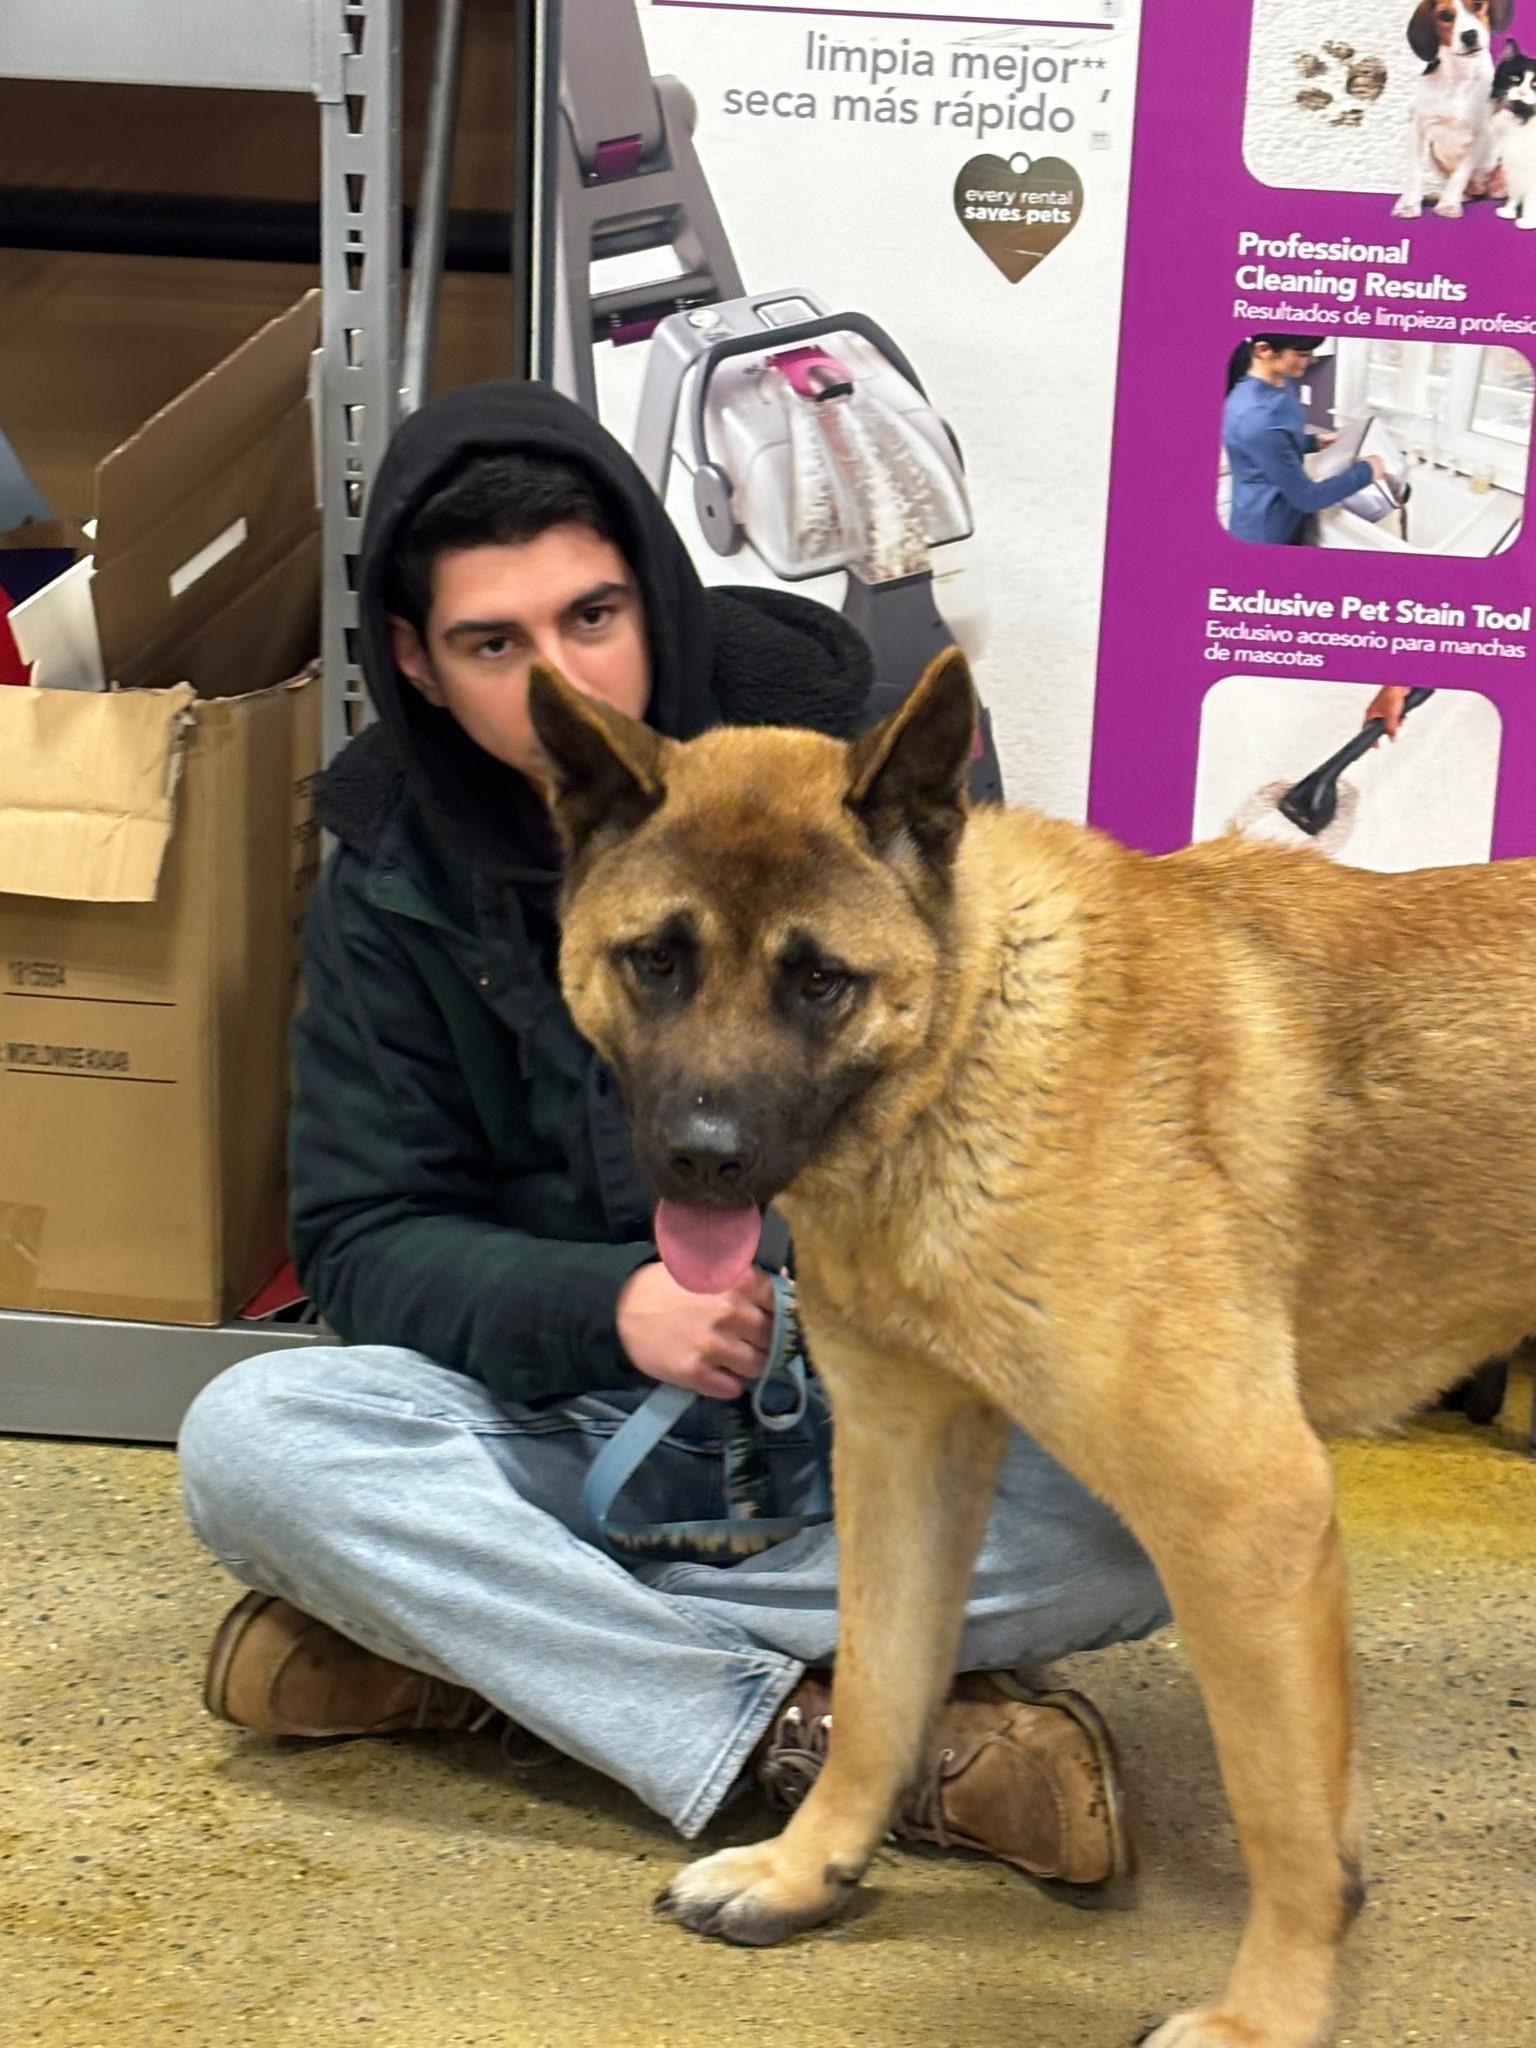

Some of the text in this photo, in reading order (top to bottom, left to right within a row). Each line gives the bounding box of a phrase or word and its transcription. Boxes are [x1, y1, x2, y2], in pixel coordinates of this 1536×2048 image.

[806, 31, 934, 85] limpia
[724, 87, 1075, 139] seca más rápido
[965, 189, 1074, 206] every rental
[964, 206, 1072, 225] saves pets
[1238, 231, 1410, 264] Professional
[1235, 265, 1467, 301] Cleaning Results
[1233, 299, 1340, 324] Resultados
[1343, 306, 1371, 325] de
[1375, 306, 1456, 331] limpieza
[1208, 588, 1531, 631] Exclusive Pet Stain Tool
[1204, 642, 1324, 667] de mascotas
[1206, 620, 1526, 658] Exclusivo accesorio para manchas
